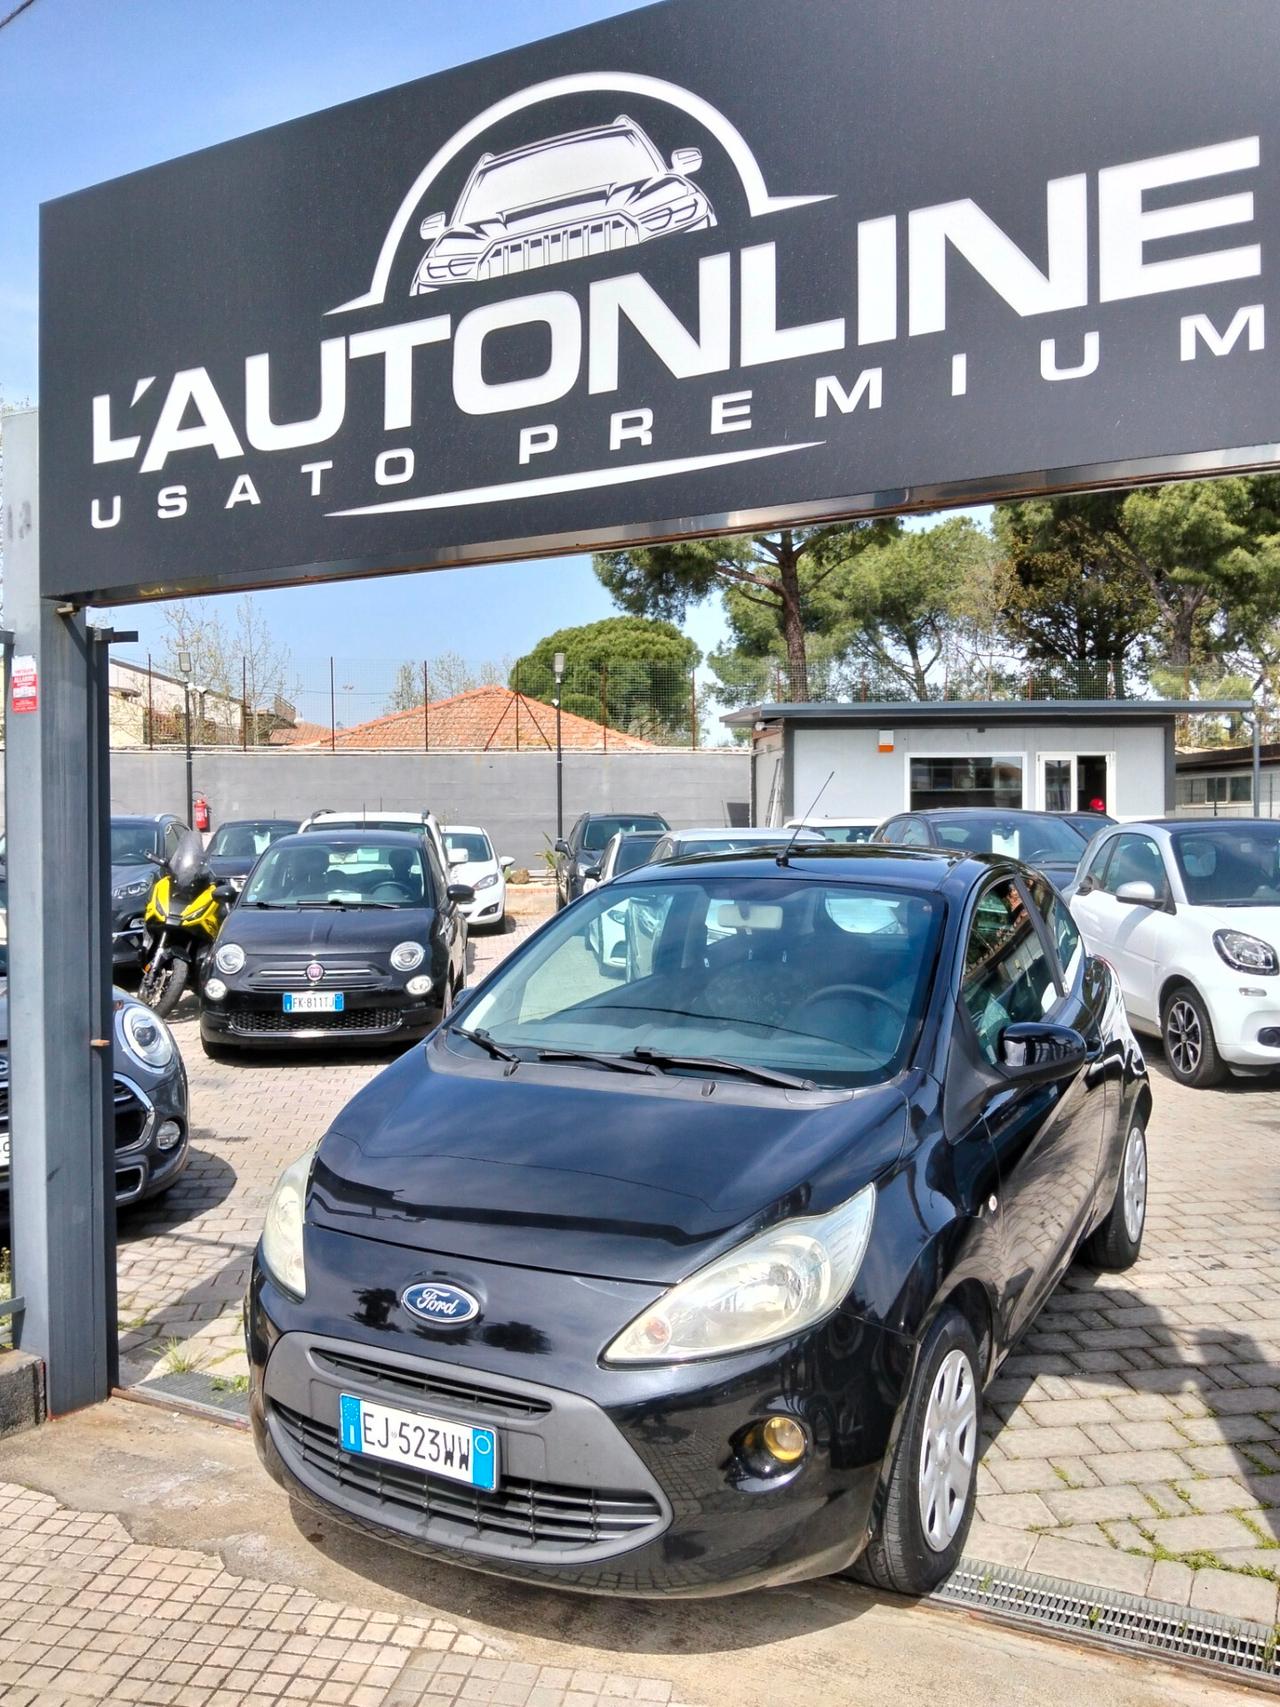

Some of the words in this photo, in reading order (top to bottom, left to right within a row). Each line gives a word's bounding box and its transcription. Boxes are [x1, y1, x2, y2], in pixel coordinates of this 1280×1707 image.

[91, 447, 415, 529] USATO
[519, 304, 1266, 464] PREMIUM
[92, 135, 1261, 473] L'AUTONLINE
[416, 1288, 459, 1315] Ford
